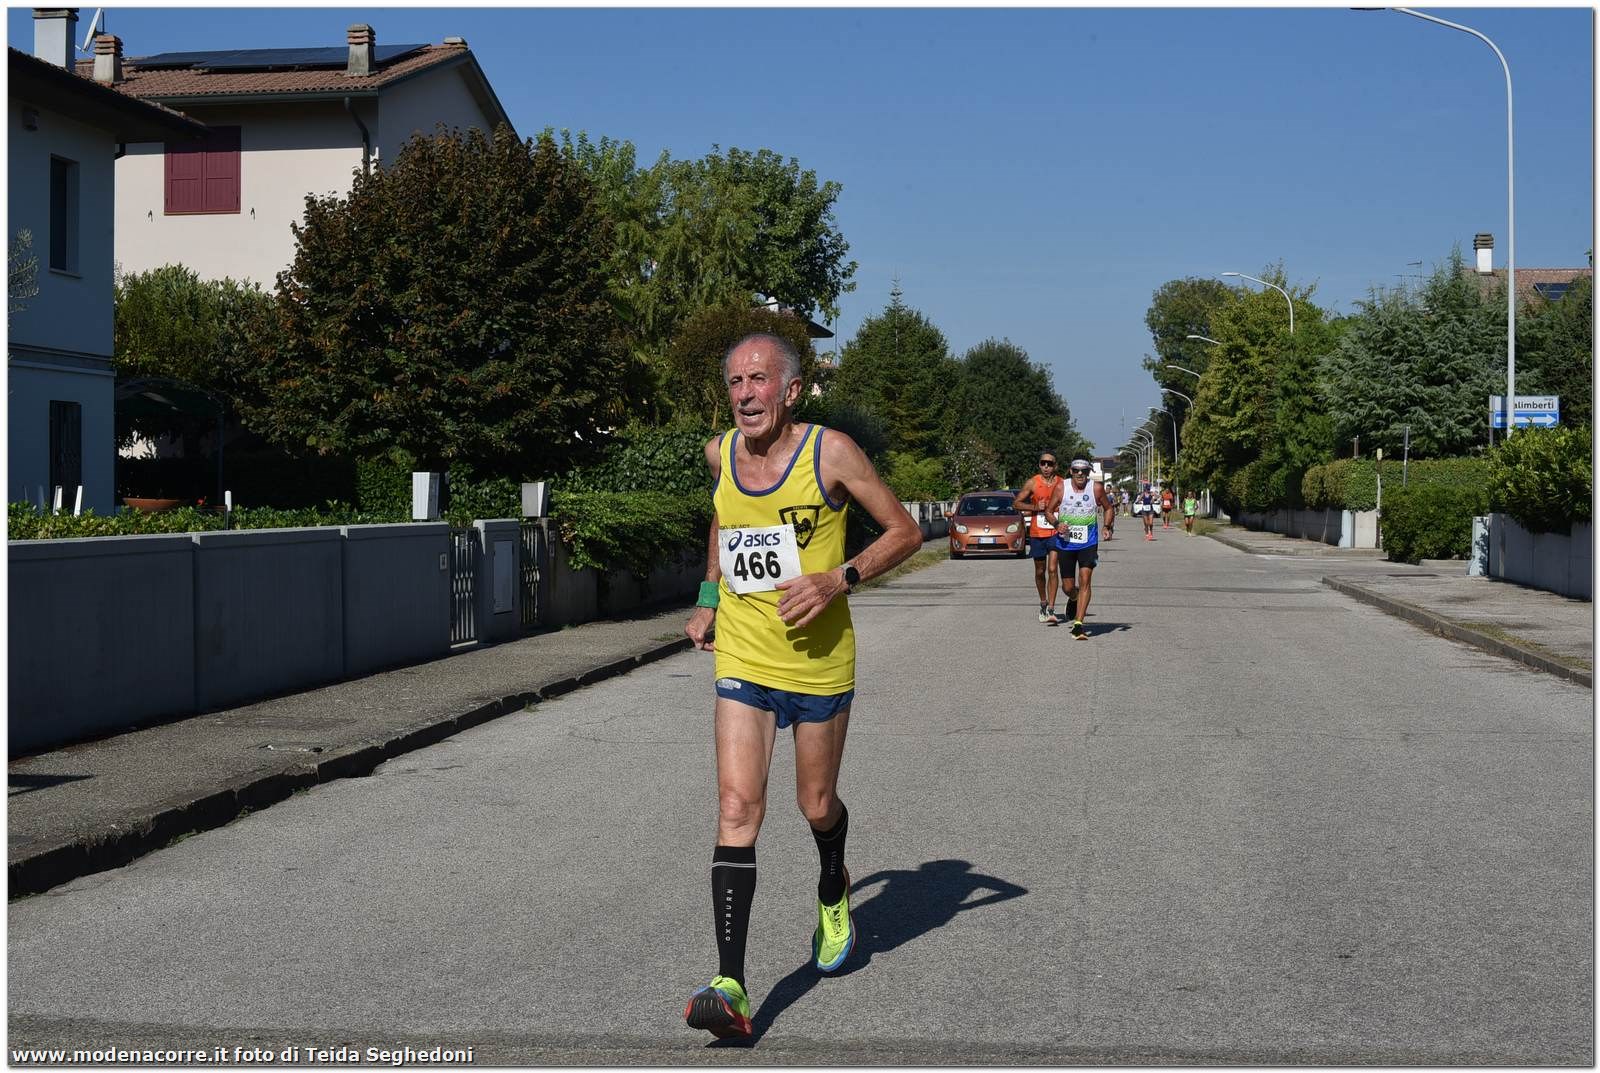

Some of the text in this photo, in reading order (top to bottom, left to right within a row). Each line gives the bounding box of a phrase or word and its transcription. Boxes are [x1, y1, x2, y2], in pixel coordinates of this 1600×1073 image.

[1513, 401, 1554, 409] alimberti
[744, 533, 780, 547] asics
[1069, 531, 1083, 540] 482
[733, 551, 781, 581] 466
[725, 888, 734, 942] OXYBURN
